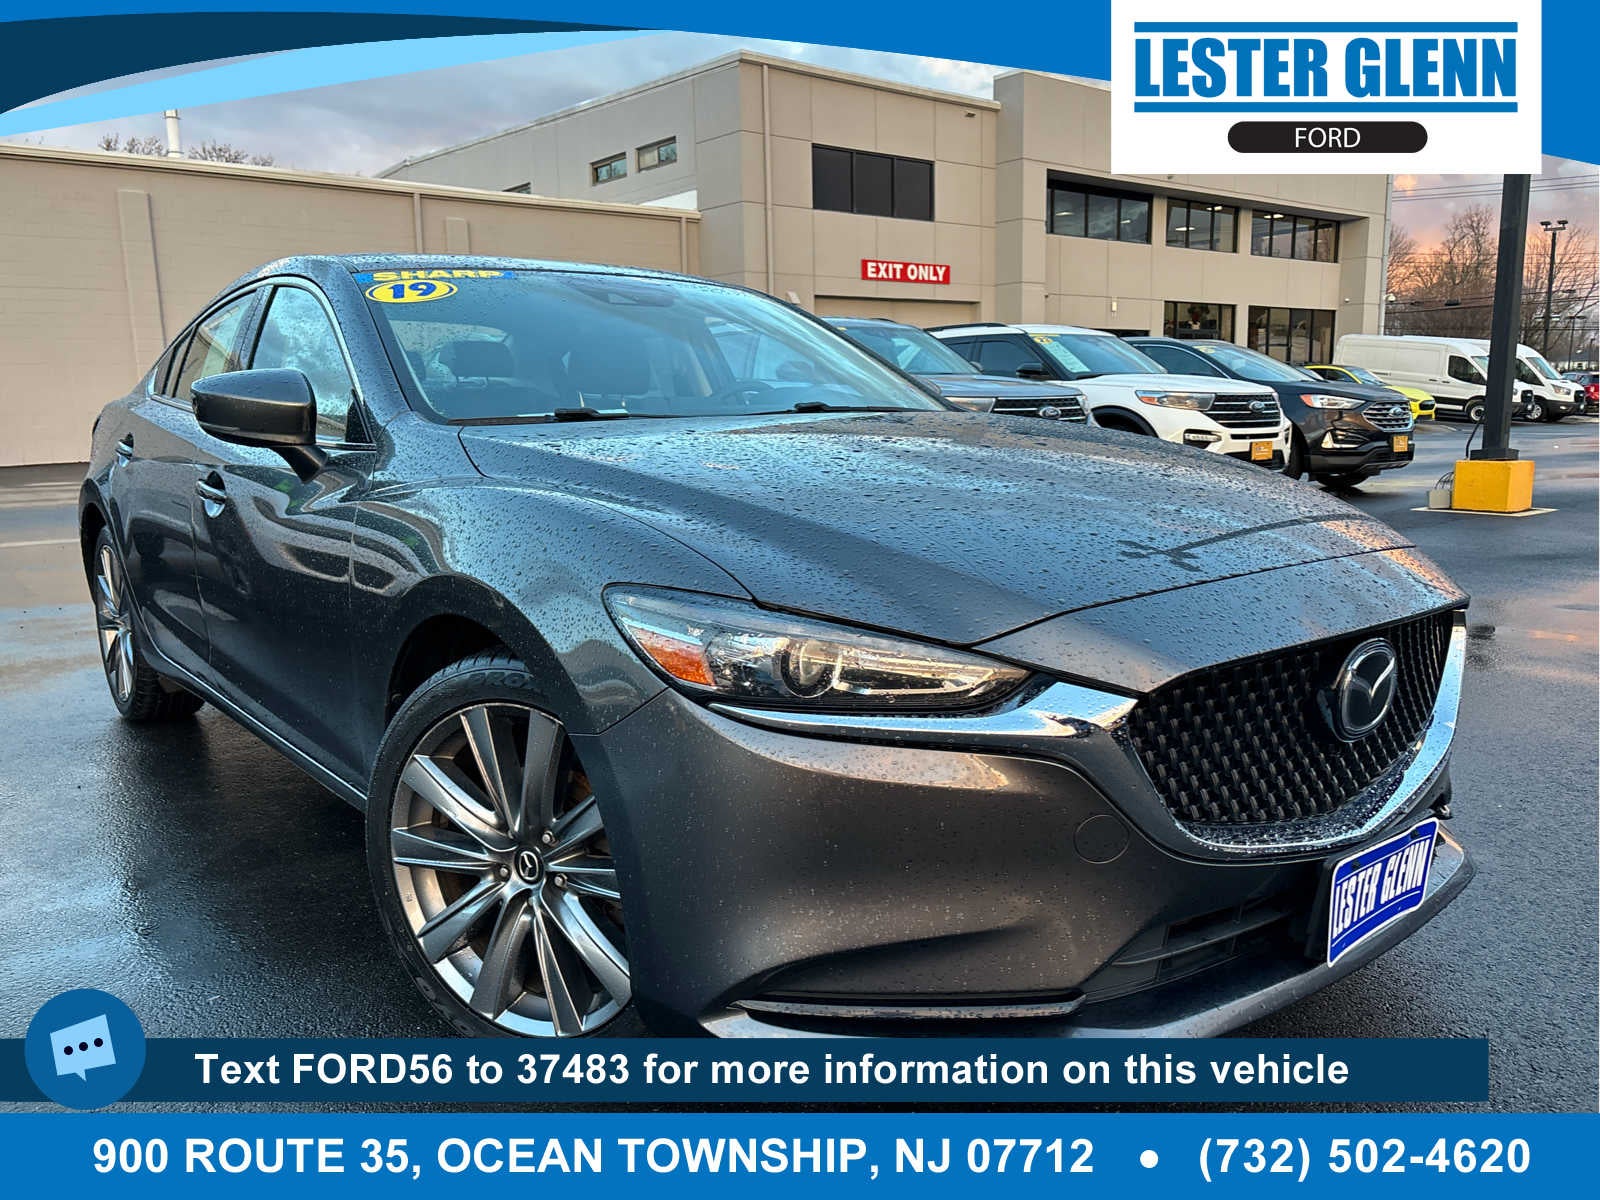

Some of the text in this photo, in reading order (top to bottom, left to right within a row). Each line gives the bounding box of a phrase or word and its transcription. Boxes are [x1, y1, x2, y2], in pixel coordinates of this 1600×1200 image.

[373, 270, 503, 281] SHARP
[867, 262, 946, 281] EXIT ONLY
[389, 282, 437, 299] 19
[1332, 839, 1430, 939] LESTER GLENN
